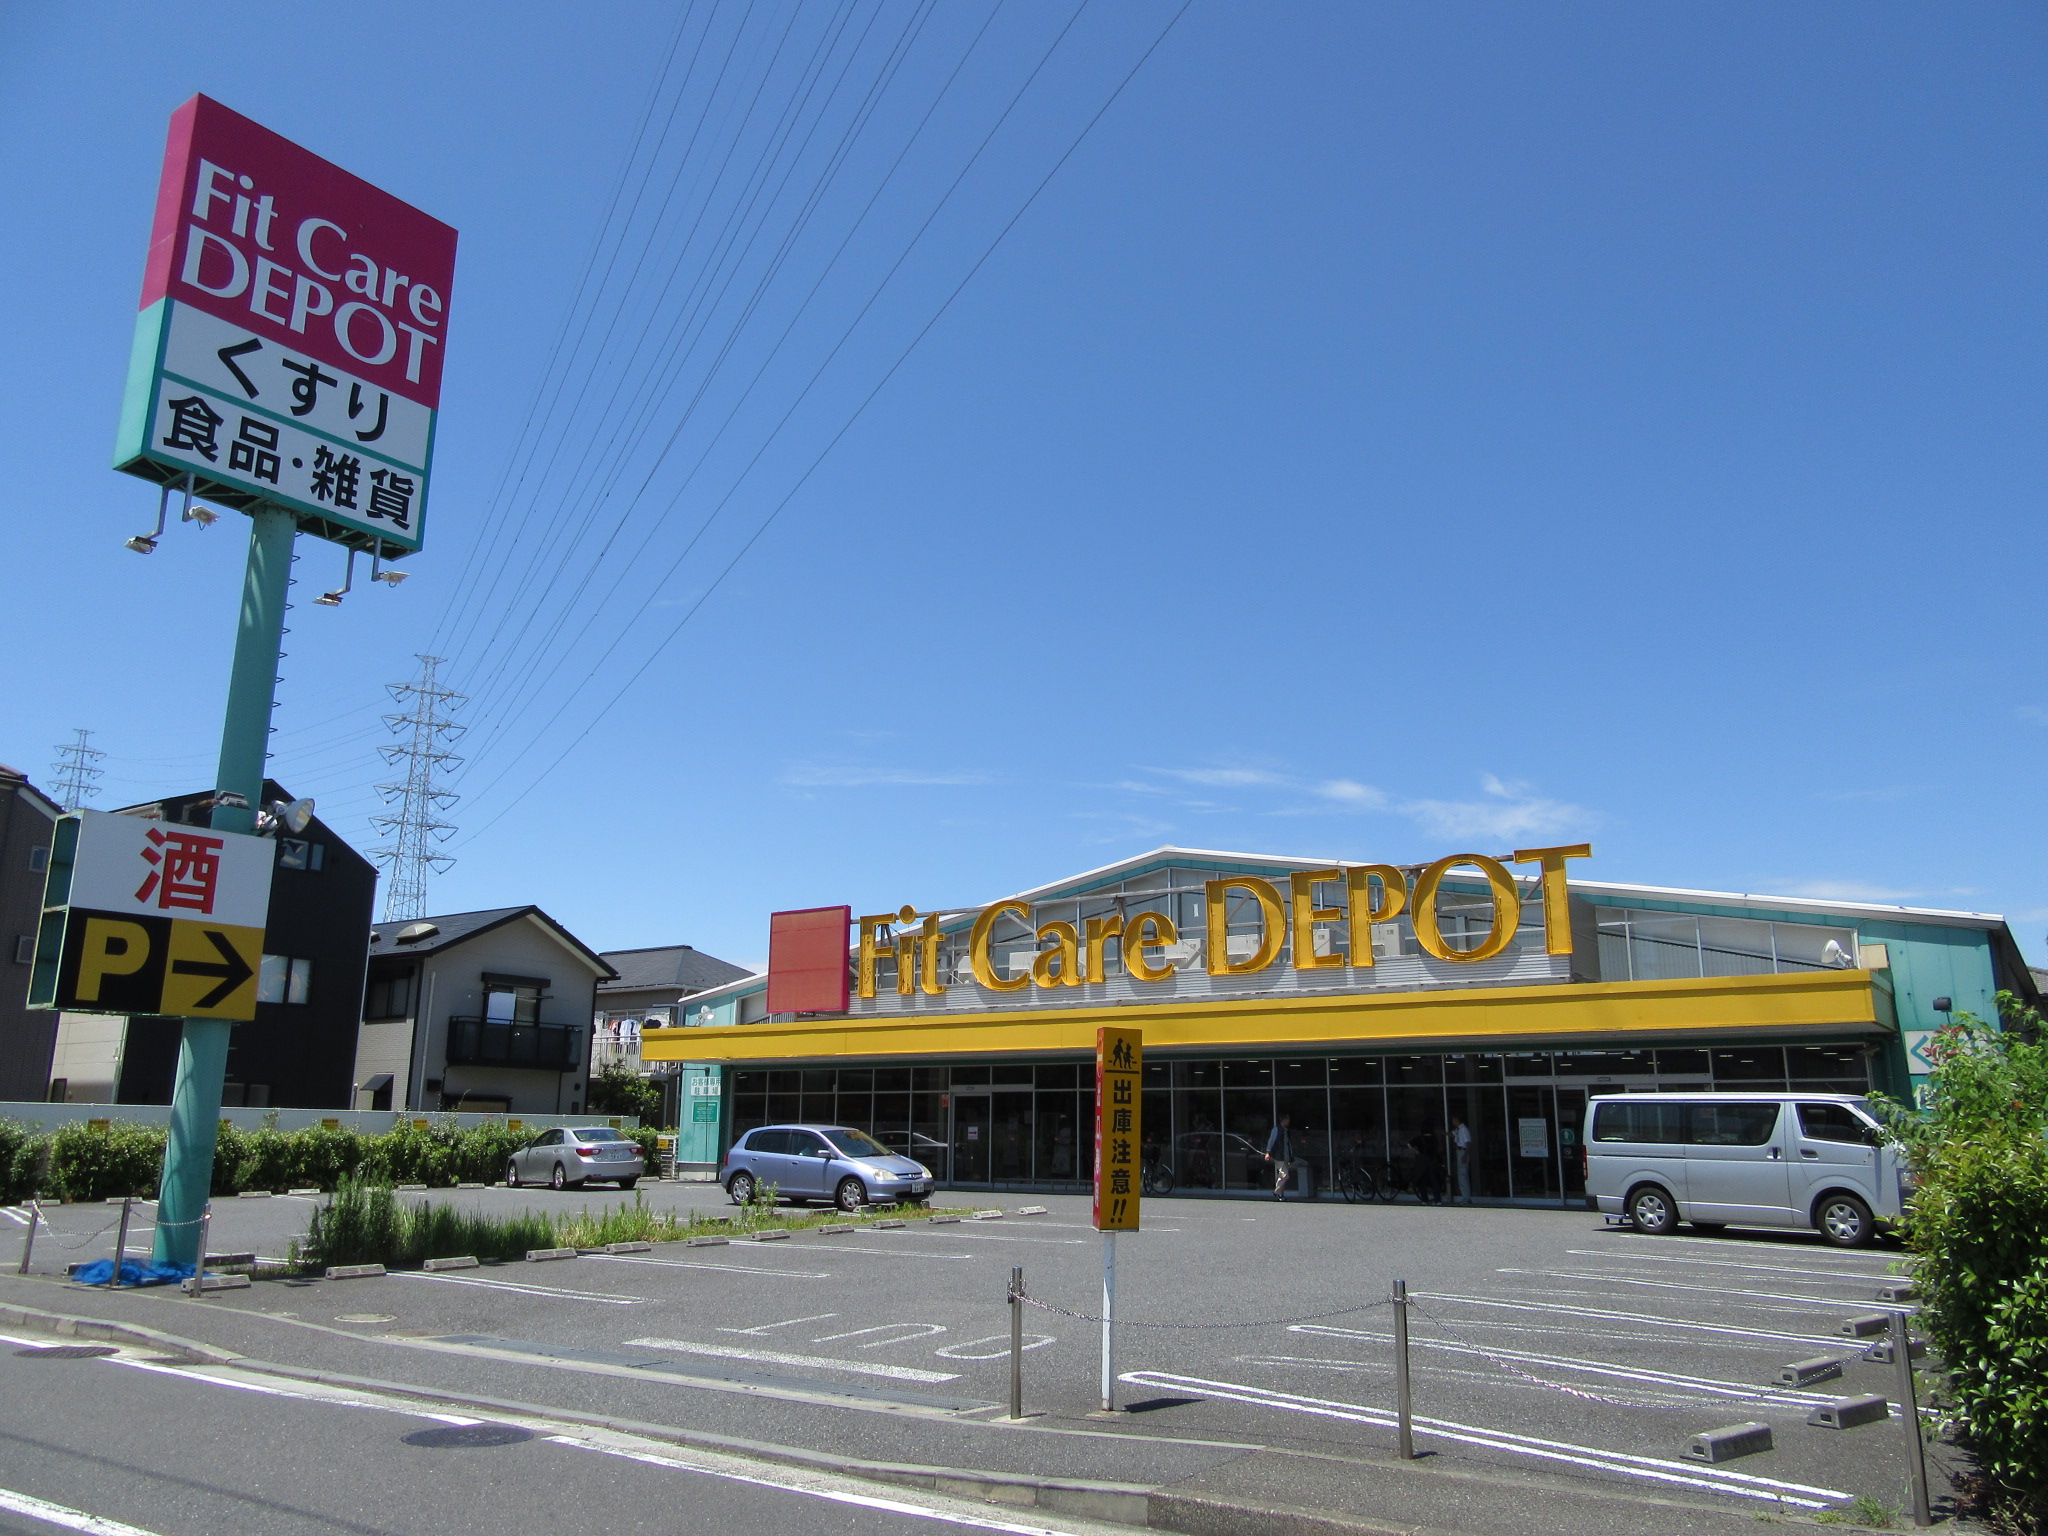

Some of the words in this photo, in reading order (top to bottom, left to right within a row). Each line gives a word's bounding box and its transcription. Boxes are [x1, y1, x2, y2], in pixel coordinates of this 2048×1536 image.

[181, 224, 438, 384] DEPOT
[192, 158, 279, 252] Fit
[297, 218, 443, 328] Care
[218, 338, 389, 441] くすり
[163, 395, 414, 531] 食品・雑貨
[134, 827, 225, 915] 酒
[857, 905, 947, 998] Fit
[969, 899, 1177, 992] Care
[1204, 843, 1592, 976] DEPOT
[75, 917, 151, 1001] P
